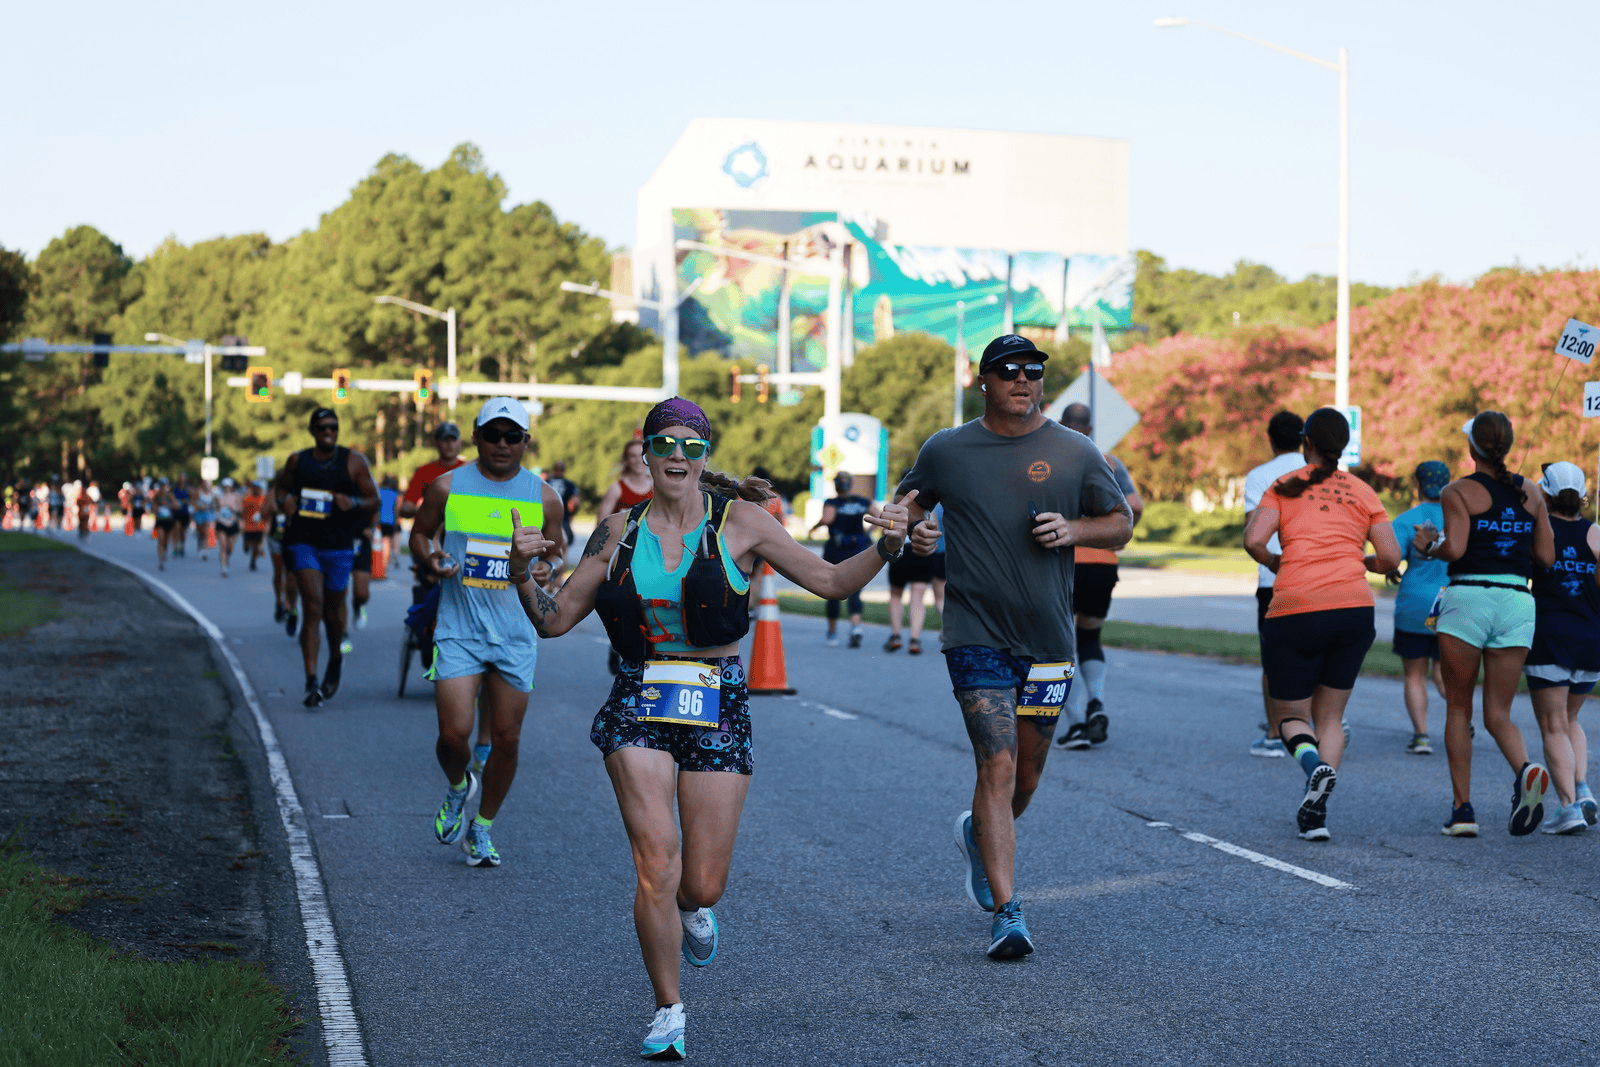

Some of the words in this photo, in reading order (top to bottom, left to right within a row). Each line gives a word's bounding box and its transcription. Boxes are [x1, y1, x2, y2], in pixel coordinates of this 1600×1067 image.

[804, 154, 971, 175] AQUARIUM
[1561, 334, 1595, 358] 12:00
[1477, 519, 1533, 533] PACER
[1546, 560, 1597, 575] ACER
[678, 689, 703, 716] 96
[1042, 682, 1066, 703] 299
